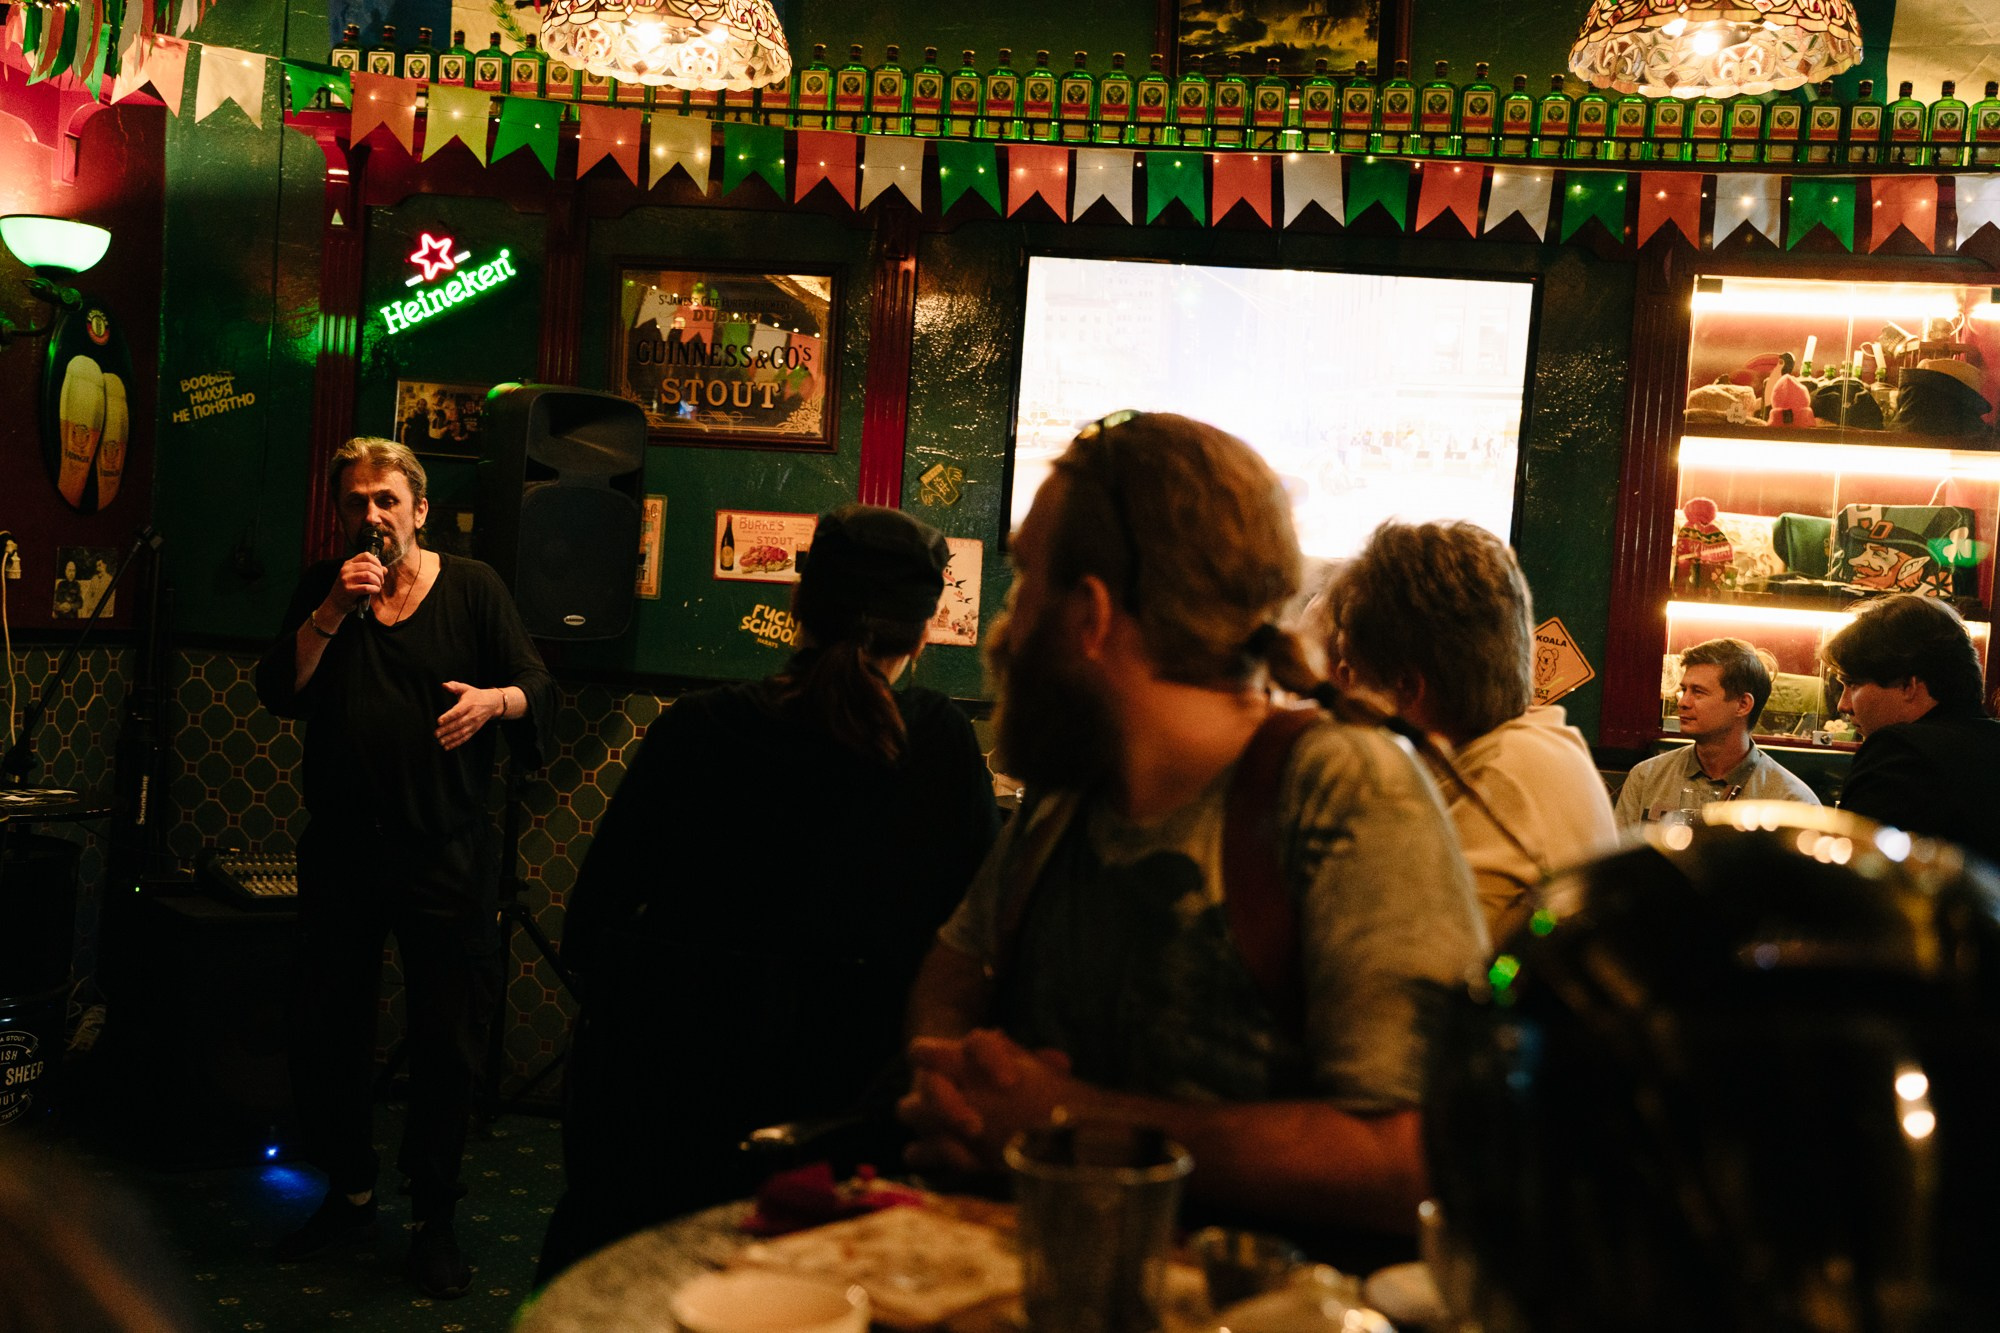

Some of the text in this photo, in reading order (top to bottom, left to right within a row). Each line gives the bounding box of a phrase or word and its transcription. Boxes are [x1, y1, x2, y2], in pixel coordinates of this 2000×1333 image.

[379, 249, 516, 335] Heineken
[190, 382, 233, 405] НИХУЯ
[661, 378, 780, 409] STOUT
[173, 392, 255, 423] НЕ ПОНЯТНО
[756, 536, 794, 545] STOUT
[1536, 634, 1567, 647] KOALA
[6, 1034, 26, 1042] STOUT
[5, 1061, 44, 1086] SHEEP
